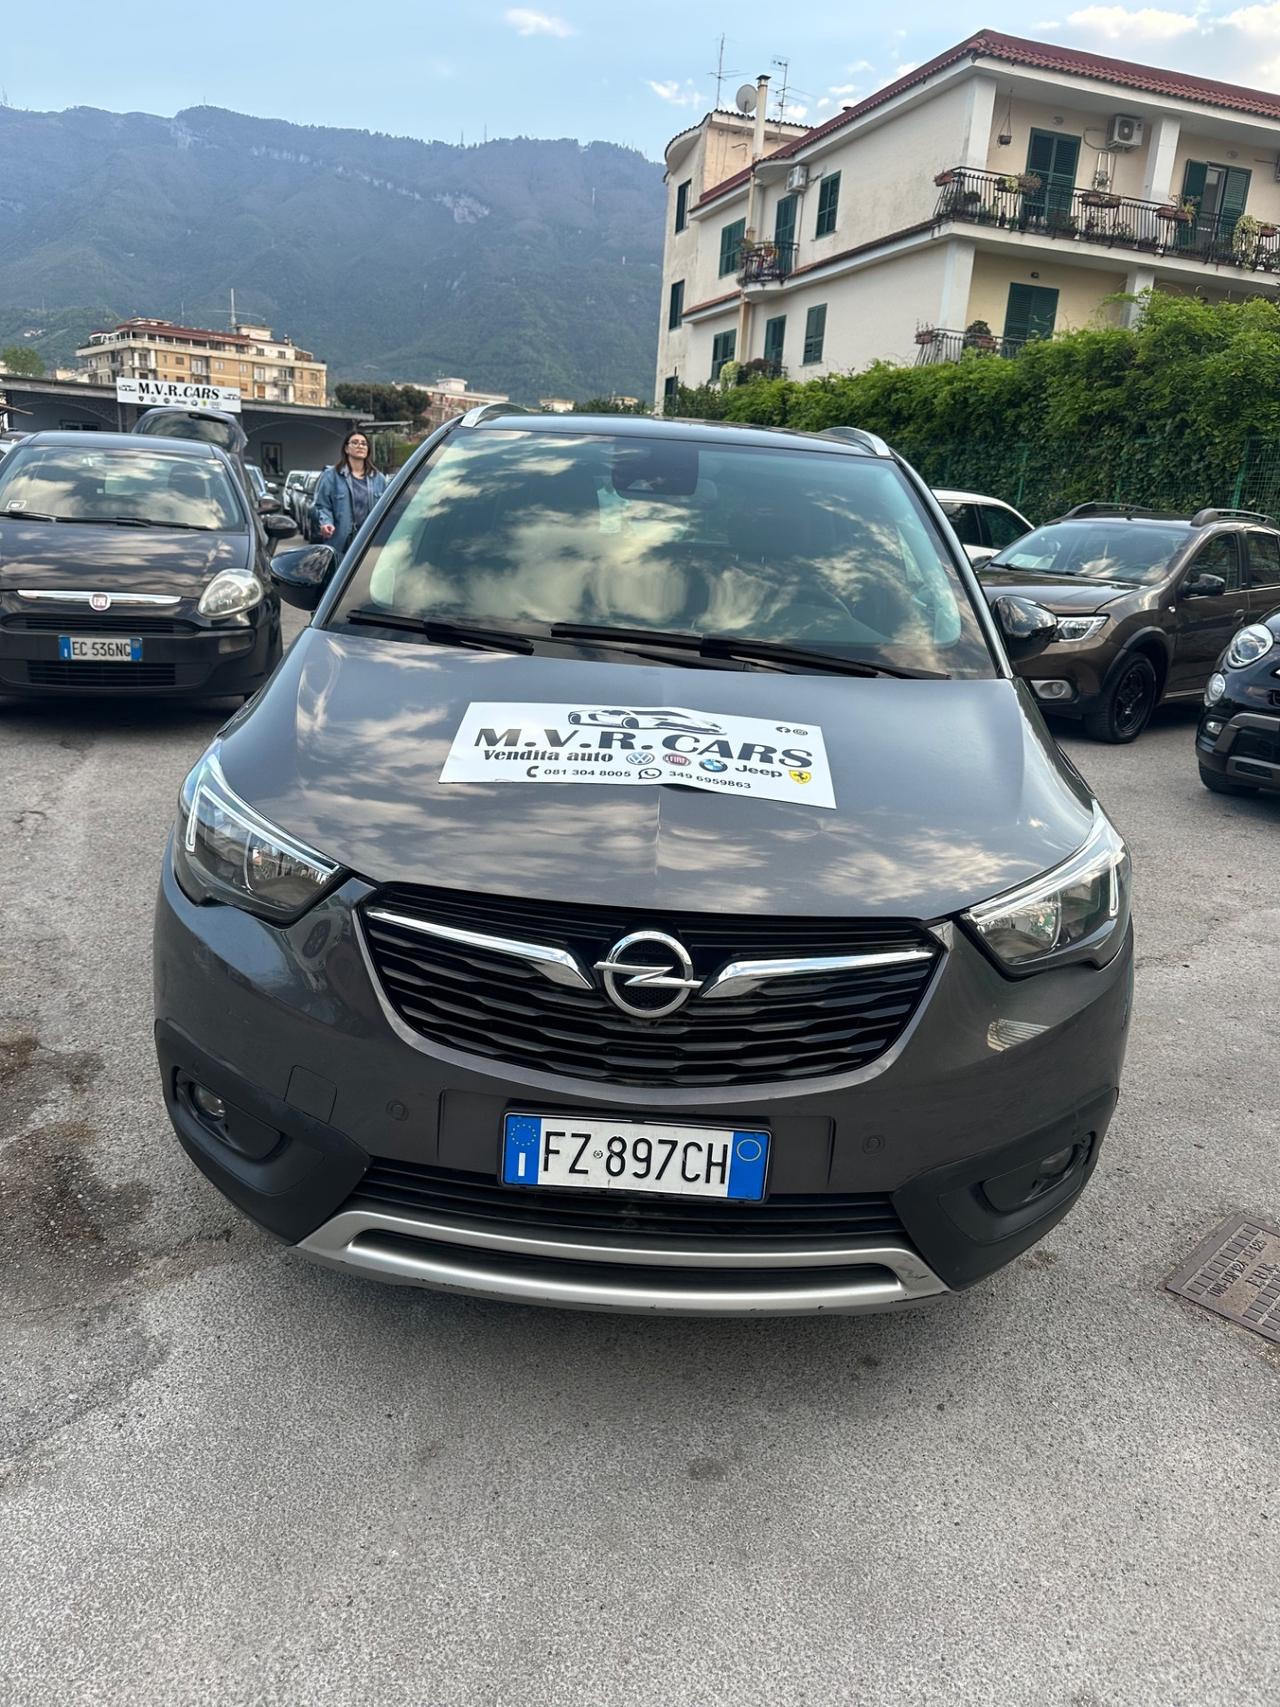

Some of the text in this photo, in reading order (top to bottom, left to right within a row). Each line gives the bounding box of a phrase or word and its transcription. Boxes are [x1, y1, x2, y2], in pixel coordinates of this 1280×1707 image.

[72, 641, 88, 656] EC
[483, 750, 614, 762] Vendita auto
[543, 768, 567, 776] 081
[599, 769, 632, 778] 8005
[735, 765, 783, 778] Jeep
[669, 770, 752, 789] 349 6959863
[543, 1131, 729, 1185] FZ 897CH
